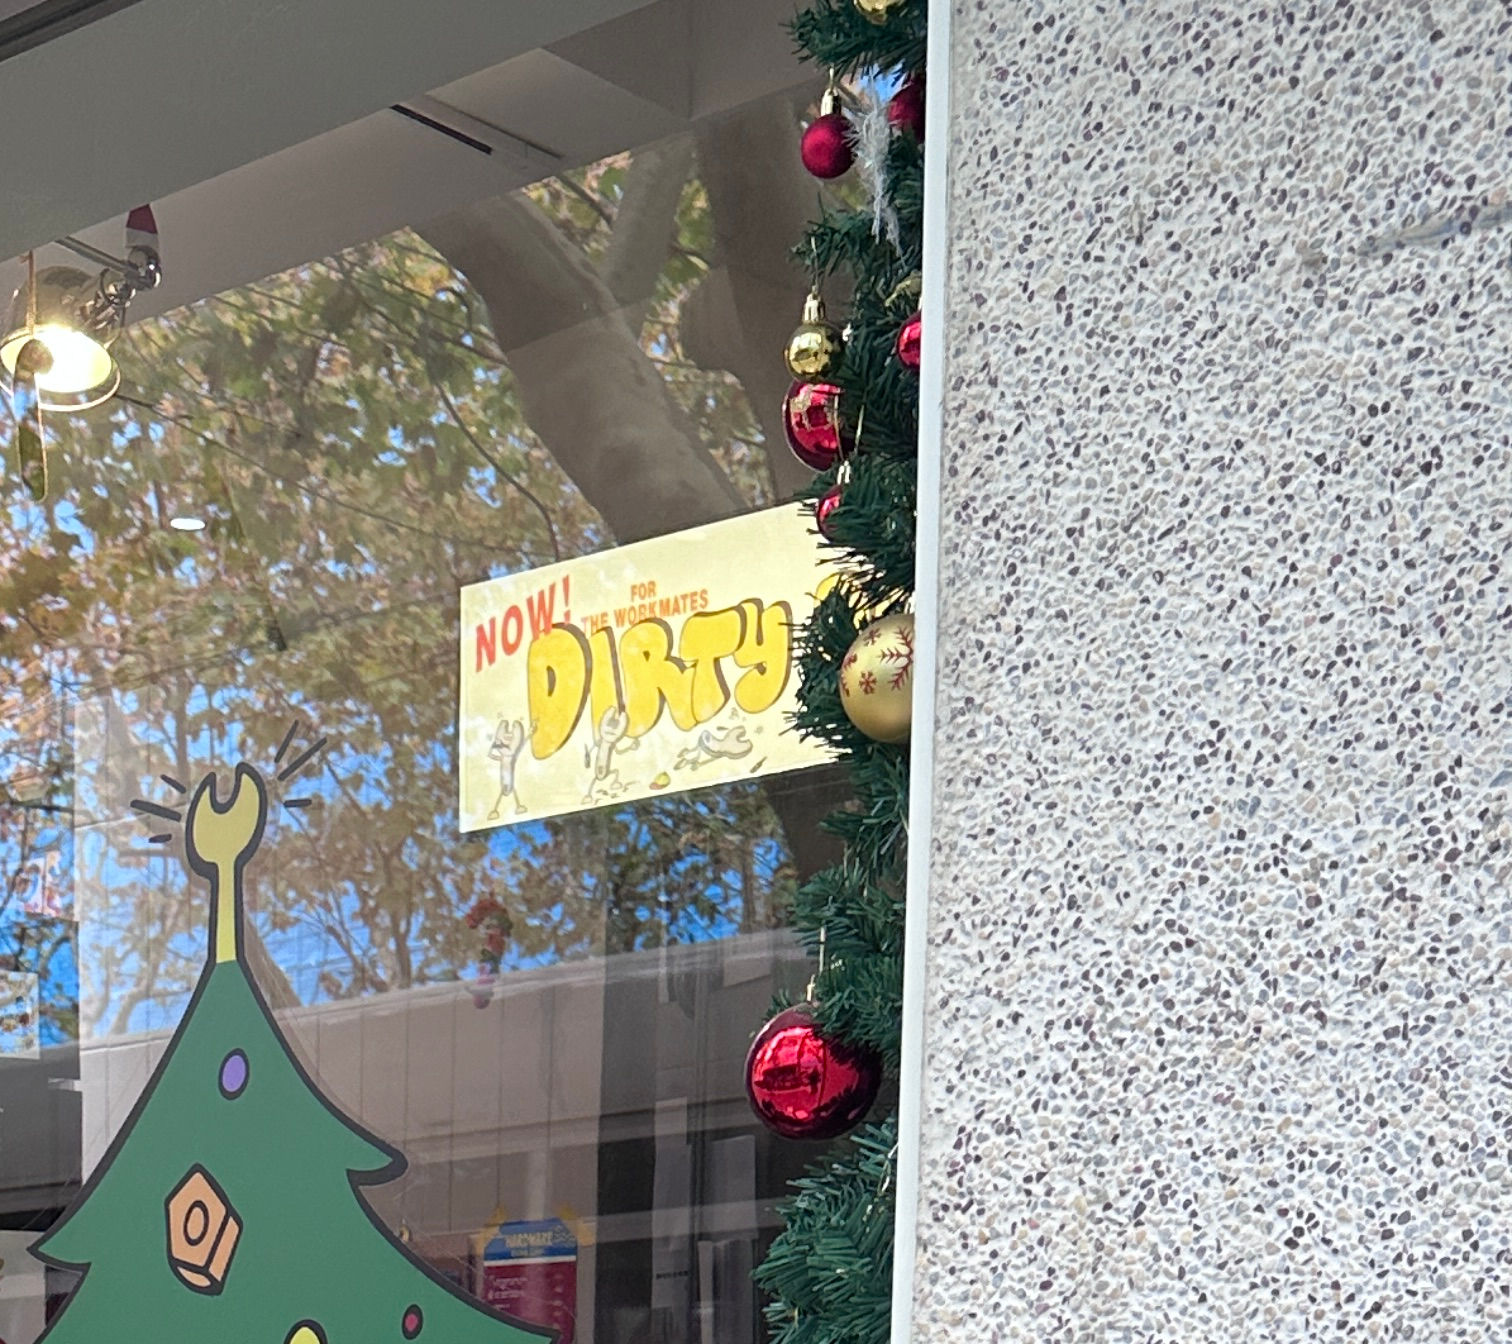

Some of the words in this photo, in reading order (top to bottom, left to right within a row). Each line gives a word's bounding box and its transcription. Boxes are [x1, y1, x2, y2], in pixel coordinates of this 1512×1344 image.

[476, 574, 570, 672] NOW!
[581, 611, 608, 634] THE
[613, 589, 709, 628] WORKMATES
[630, 580, 657, 602] FOR
[526, 598, 793, 760] DIRTY
